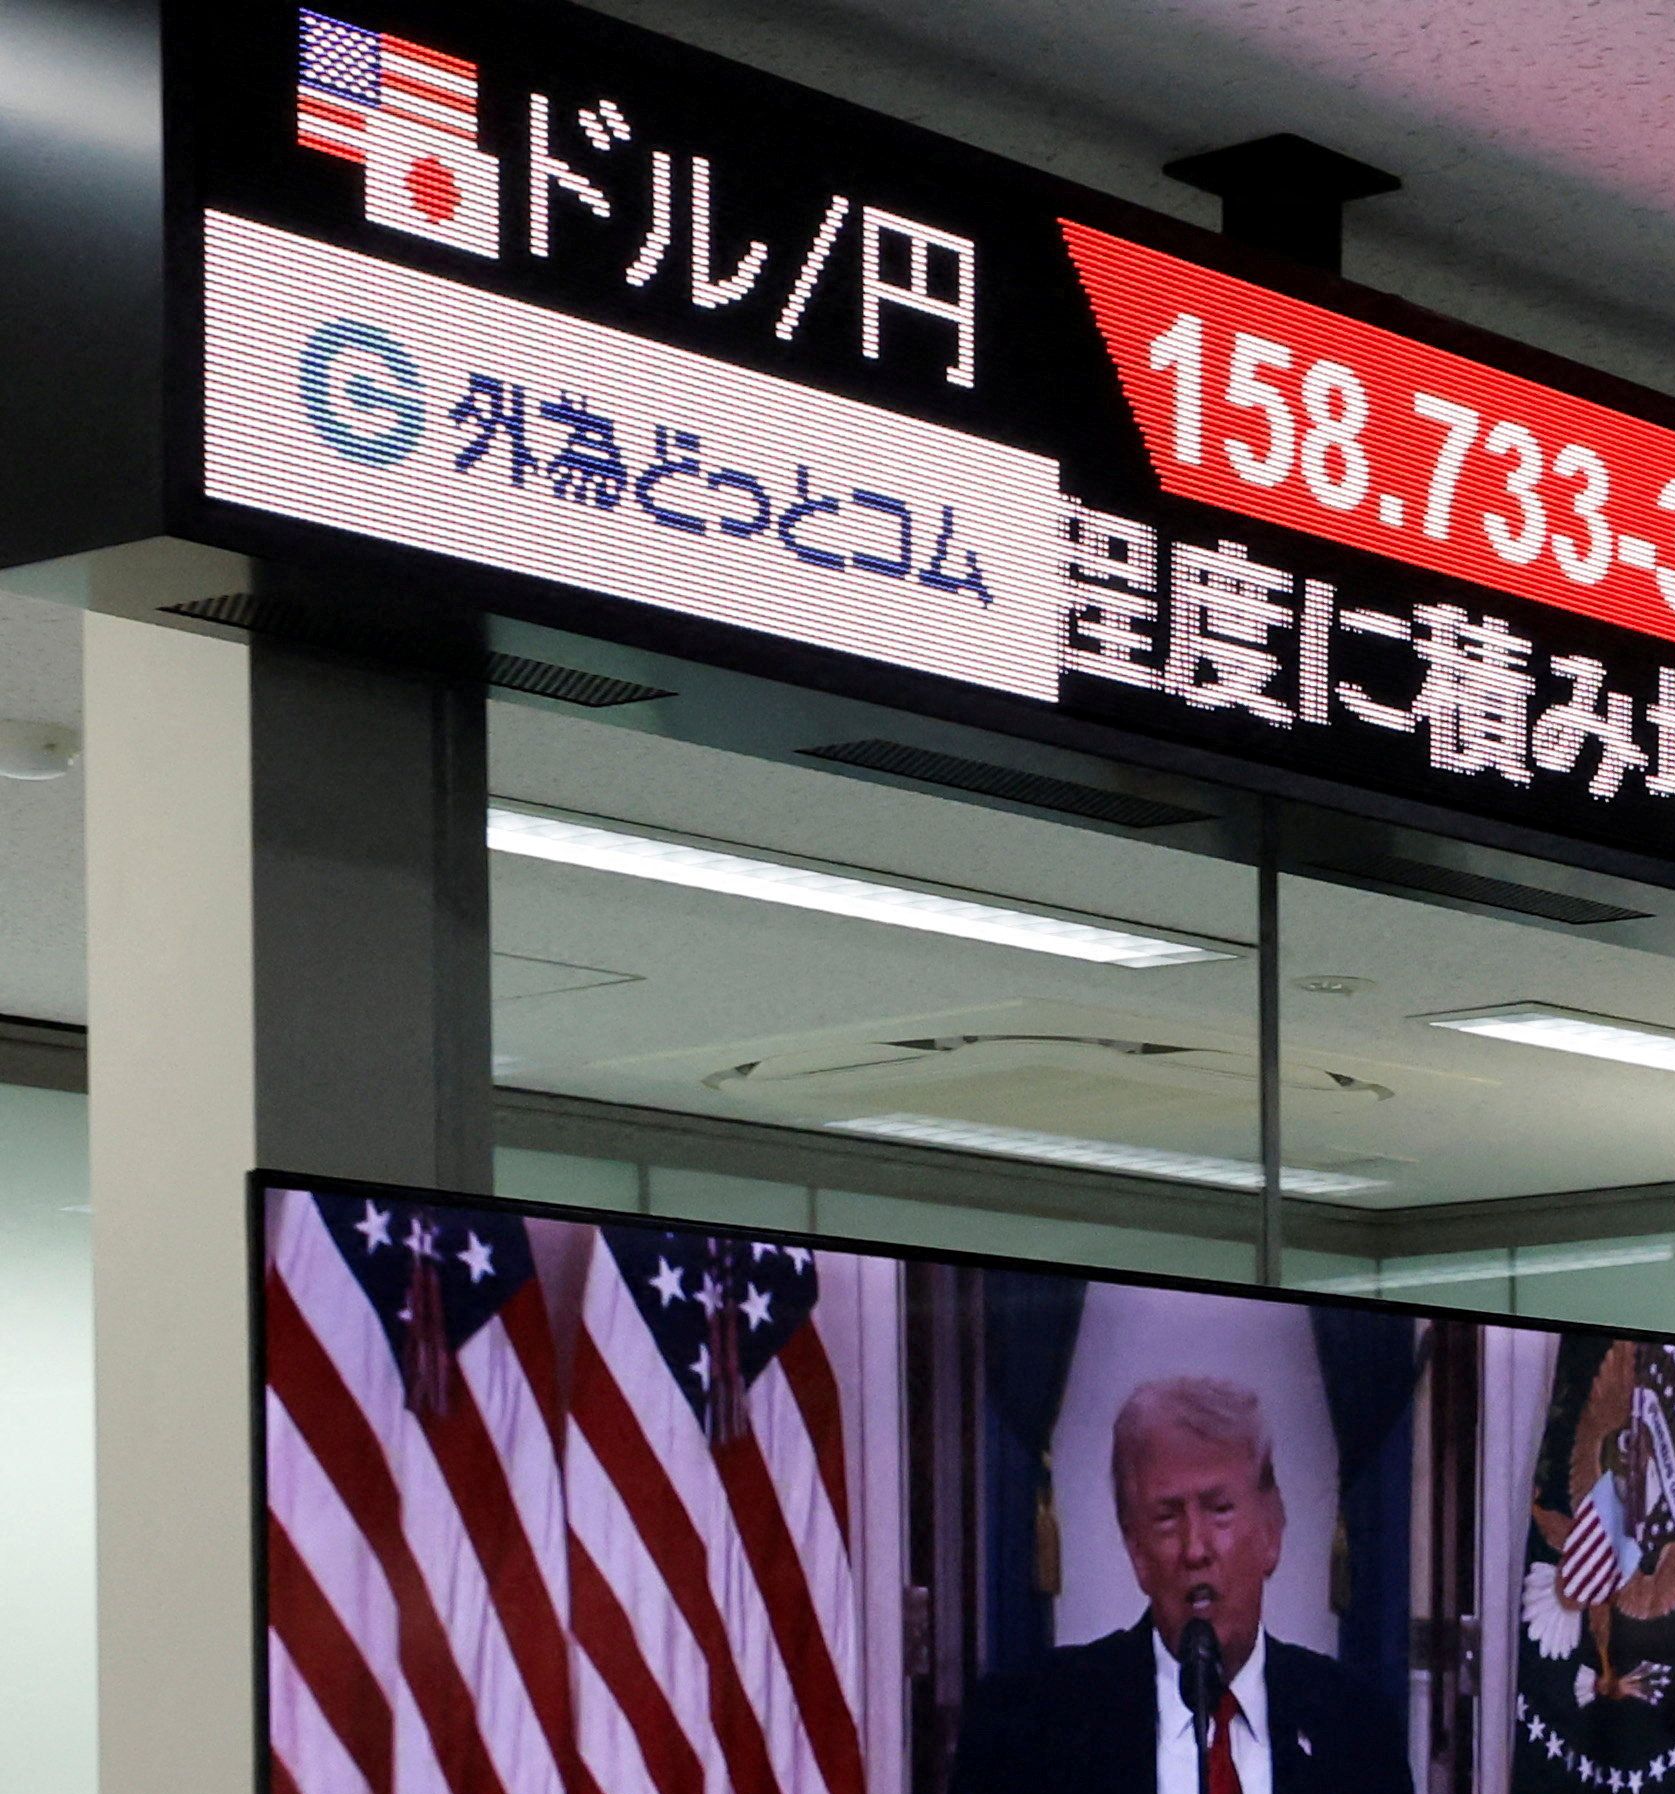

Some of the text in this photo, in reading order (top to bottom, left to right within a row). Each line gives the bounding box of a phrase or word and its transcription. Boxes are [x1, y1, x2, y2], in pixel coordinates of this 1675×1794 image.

[529, 92, 975, 388] ドル/円
[447, 372, 995, 608] 外為どっとコム
